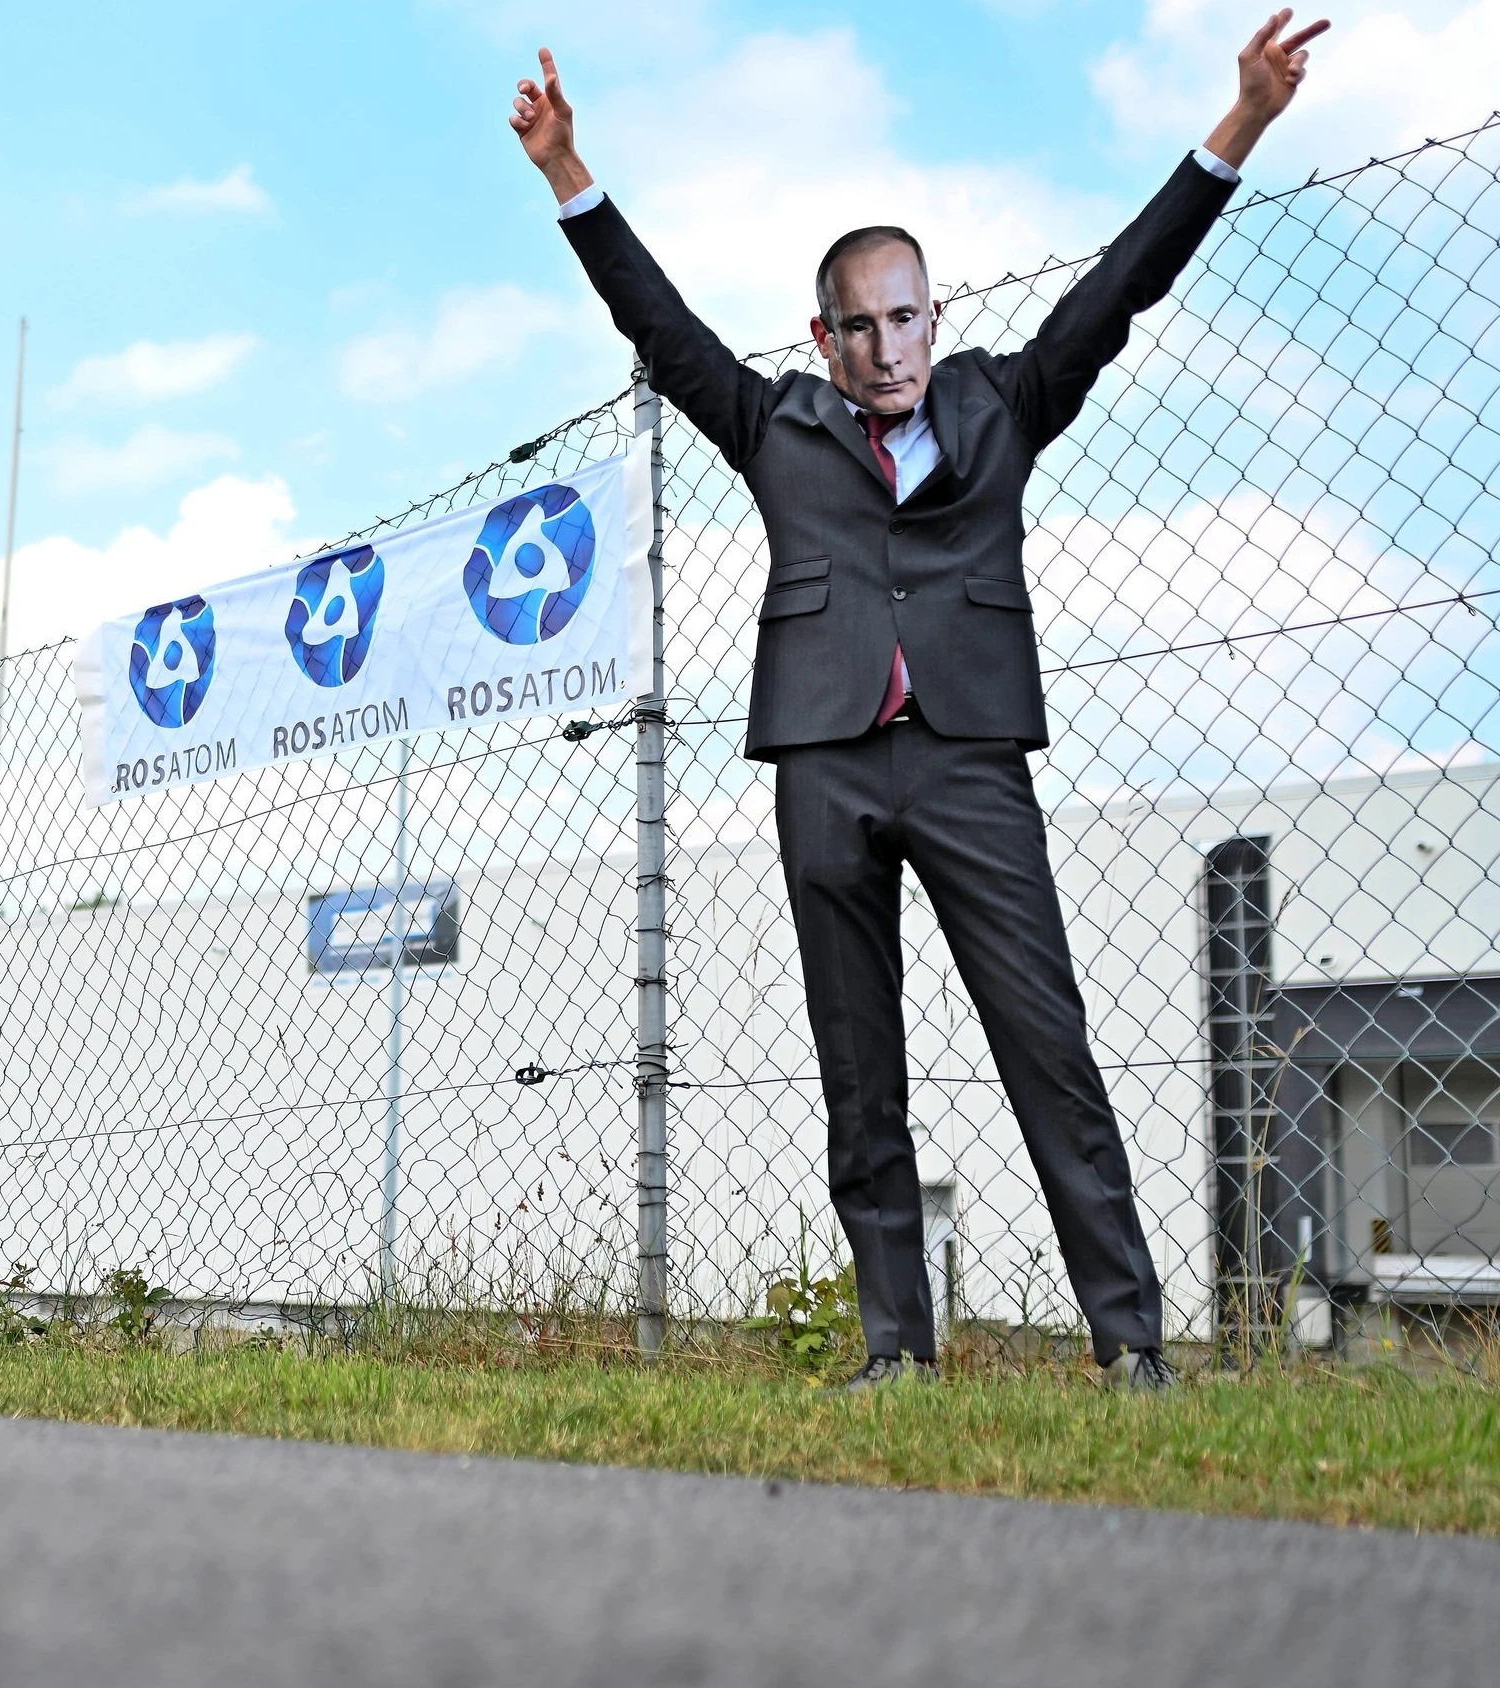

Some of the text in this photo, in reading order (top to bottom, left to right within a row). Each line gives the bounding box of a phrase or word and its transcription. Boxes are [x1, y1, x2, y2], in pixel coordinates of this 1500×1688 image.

[447, 657, 616, 721] ROSATOM
[273, 697, 409, 758] ROSATOM
[116, 738, 237, 792] ROSATOM
